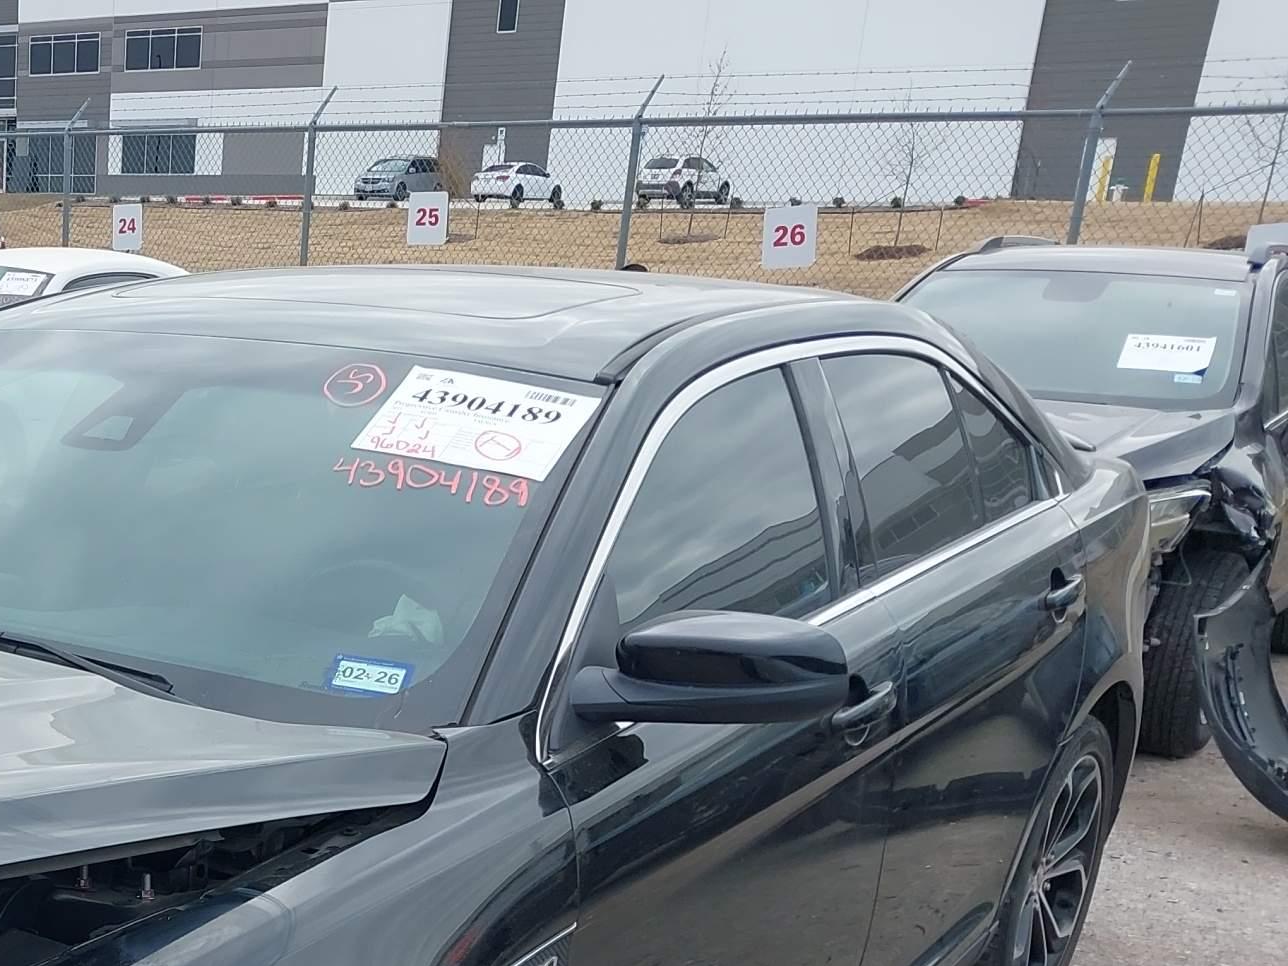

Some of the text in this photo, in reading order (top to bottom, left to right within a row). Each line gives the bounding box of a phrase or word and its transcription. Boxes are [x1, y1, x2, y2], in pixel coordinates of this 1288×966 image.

[118, 217, 137, 234] 24
[415, 207, 440, 227] 25
[773, 223, 806, 247] 26
[411, 388, 562, 425] 43904189
[333, 457, 530, 507] 43904189
[342, 666, 401, 686] 02 26
